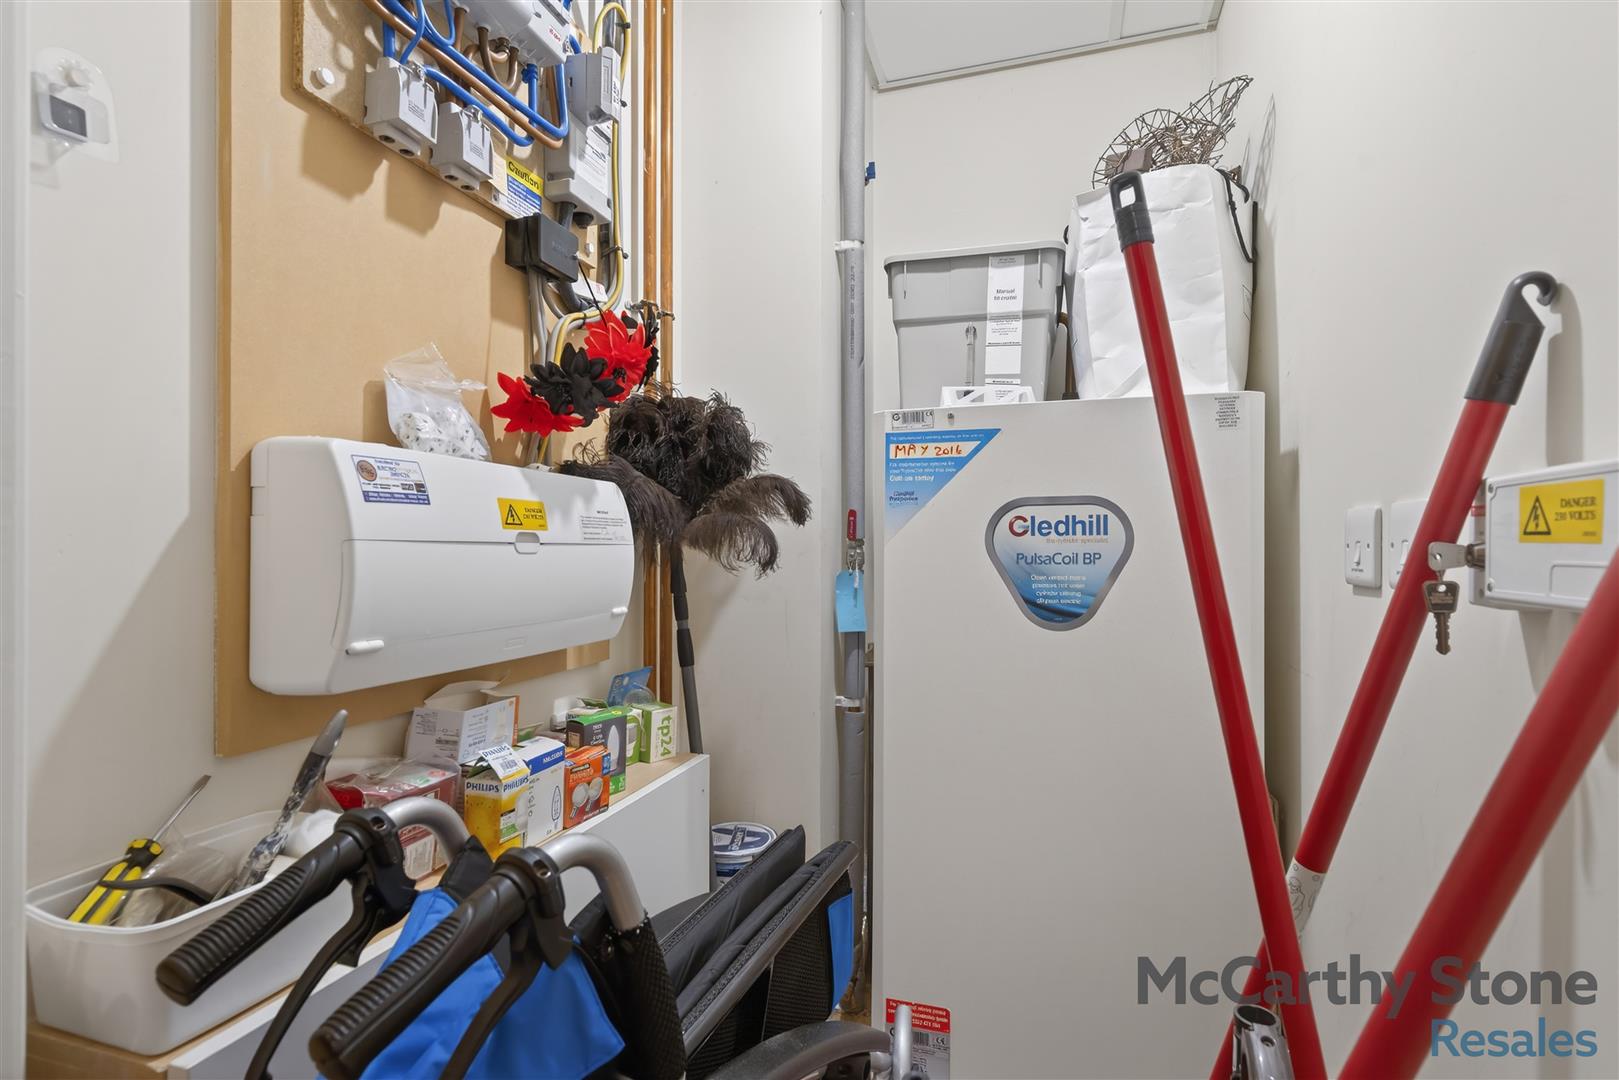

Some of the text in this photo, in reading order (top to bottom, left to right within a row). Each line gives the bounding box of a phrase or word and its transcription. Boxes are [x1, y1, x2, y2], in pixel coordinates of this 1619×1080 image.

[894, 444, 962, 458] MAY 2016
[1560, 497, 1597, 508] DANGER
[1568, 510, 1597, 520] VOLTS
[1008, 514, 1109, 537] Gledhill
[1016, 552, 1102, 565] PulsaCoil BP
[658, 715, 672, 757] tp24
[466, 782, 499, 792] PHILIPS
[503, 775, 529, 793] PHILIPS
